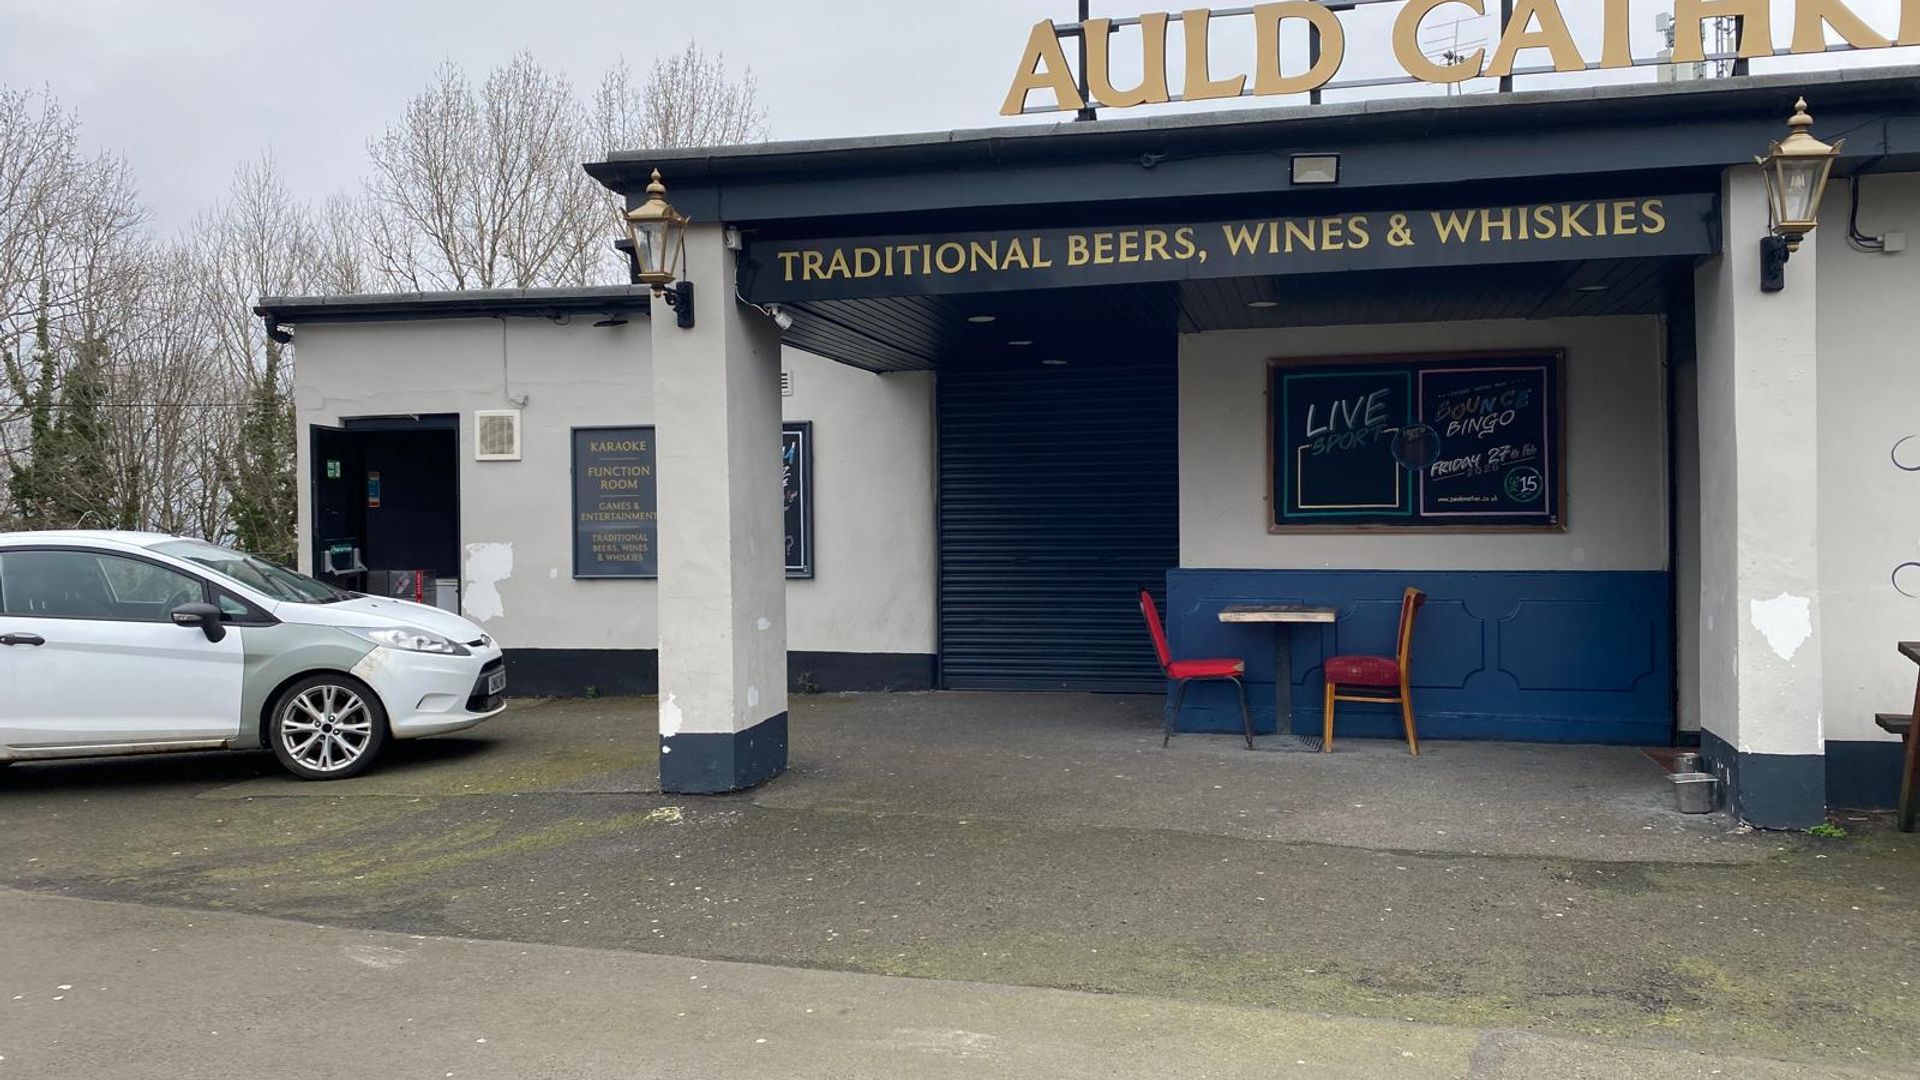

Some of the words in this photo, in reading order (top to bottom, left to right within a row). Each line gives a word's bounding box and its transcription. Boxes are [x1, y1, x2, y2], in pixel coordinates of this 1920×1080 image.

[1000, 3, 1345, 115] AULD
[778, 237, 1052, 281] TRADITIONAL
[1068, 226, 1207, 266] BEERS,
[1222, 216, 1370, 256] WINES
[1386, 213, 1415, 247] &
[1430, 199, 1667, 243] WHISKIES
[1306, 387, 1391, 437] LIVE
[1434, 387, 1532, 422] BOUNCE
[1446, 410, 1515, 439] BINGO
[590, 441, 646, 452] KARAOKE
[1311, 424, 1388, 456] SPORT
[588, 466, 650, 477] FUNCTION
[1430, 453, 1482, 477] FRIDAY
[600, 479, 638, 490] ROOM
[599, 502, 631, 510] GAMES
[633, 501, 640, 509] &
[592, 533, 648, 542] TRADITIONAL
[622, 543, 648, 552] WINES
[597, 554, 604, 562] &
[606, 553, 643, 562] WHISKIES
